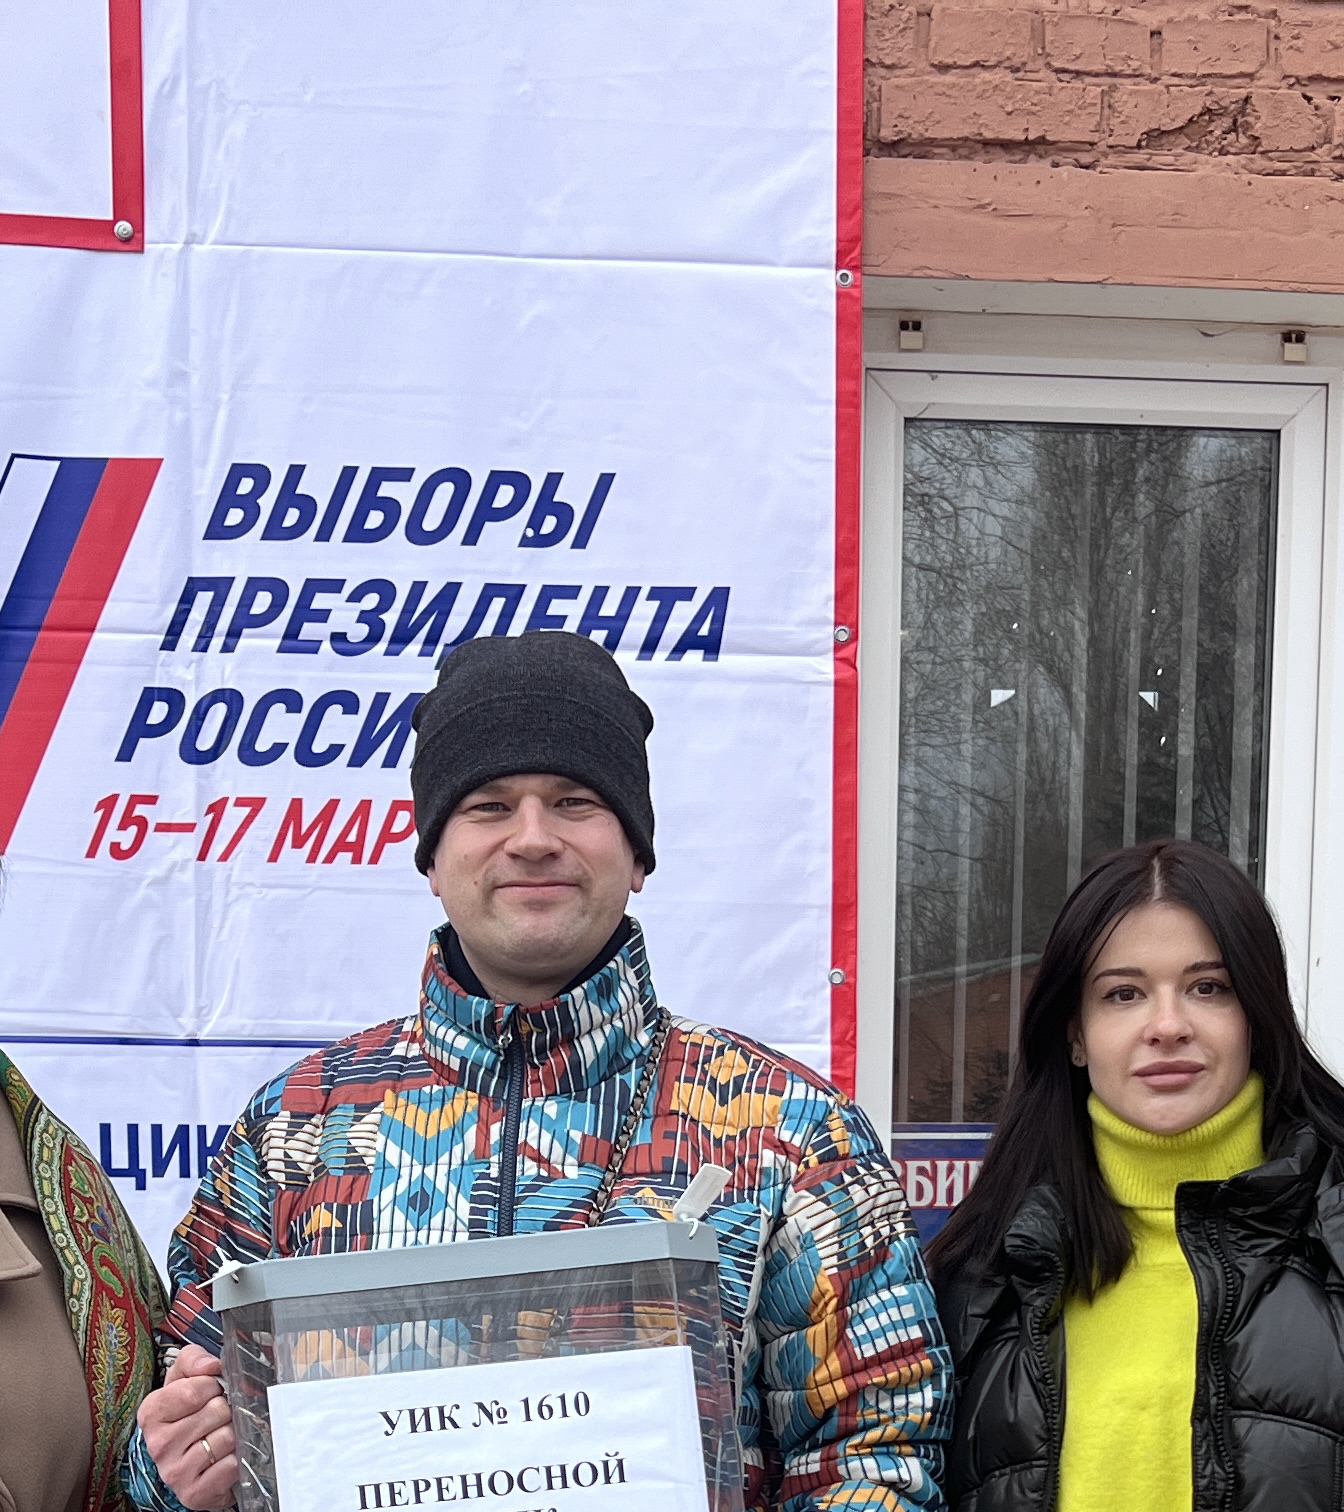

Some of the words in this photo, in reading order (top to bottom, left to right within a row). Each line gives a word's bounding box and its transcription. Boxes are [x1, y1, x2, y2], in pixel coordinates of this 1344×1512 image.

[203, 462, 615, 549] ВЫБОРЫ
[159, 576, 731, 670] ПРЕЗИДЕНТА
[115, 687, 426, 769] РОССИ
[84, 793, 253, 862] 15–17
[267, 797, 417, 865] МАР
[377, 1404, 460, 1437] УИК
[471, 1400, 508, 1428] №
[519, 1391, 591, 1422] 1610
[355, 1451, 629, 1510] ПЕРЕНОСНОЙ
